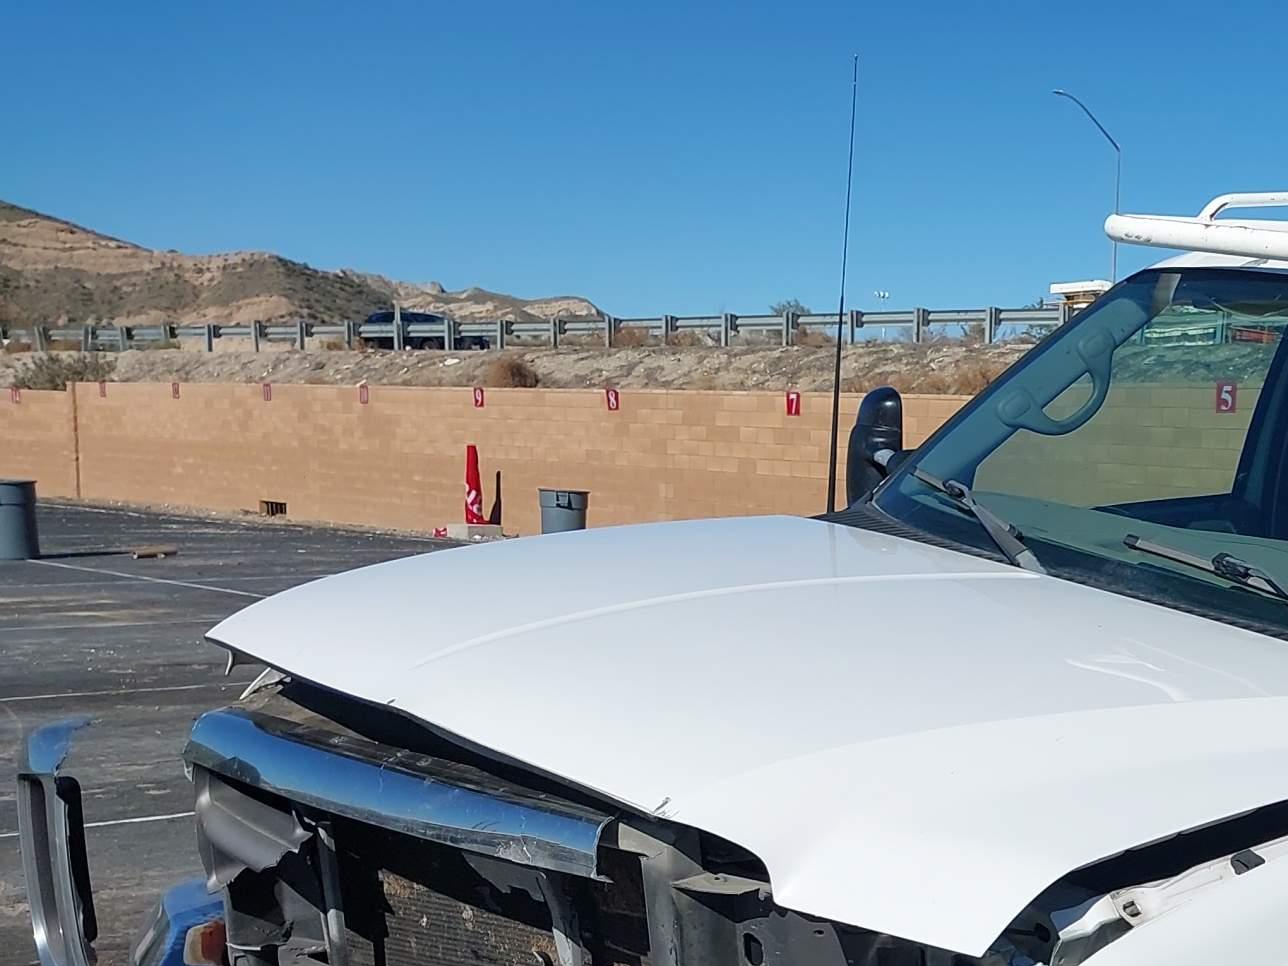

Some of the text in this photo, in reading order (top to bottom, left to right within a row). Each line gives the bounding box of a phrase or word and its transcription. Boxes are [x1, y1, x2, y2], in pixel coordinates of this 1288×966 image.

[475, 388, 483, 407] 9
[608, 390, 617, 410] 8
[789, 393, 798, 415] 7
[1220, 385, 1233, 411] 5
